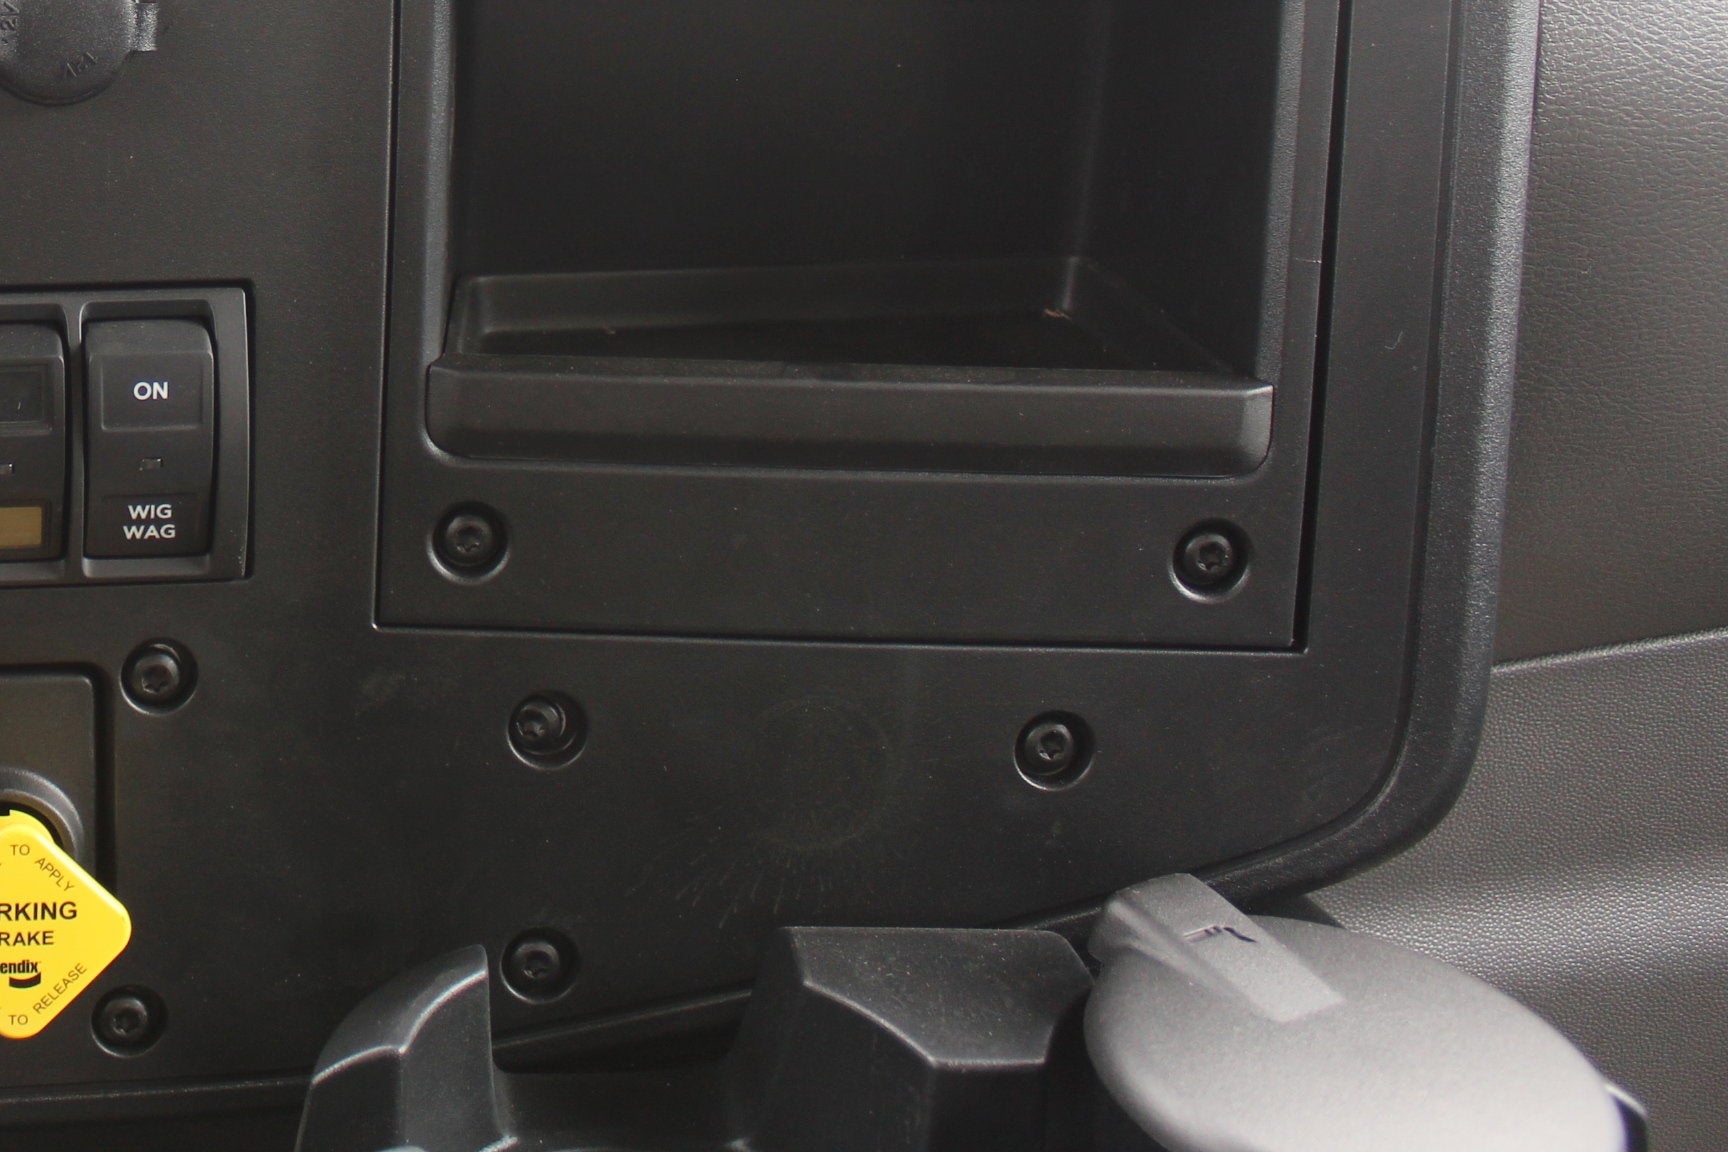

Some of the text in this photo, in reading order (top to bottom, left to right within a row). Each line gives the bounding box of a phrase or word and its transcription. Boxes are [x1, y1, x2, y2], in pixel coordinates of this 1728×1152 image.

[133, 381, 168, 400] ON
[127, 503, 172, 520] WIG
[123, 523, 176, 540] WAG
[10, 843, 31, 857] TO
[34, 857, 75, 892] APPLY
[8, 1014, 29, 1027] TO
[32, 962, 87, 1014] RELEASE
